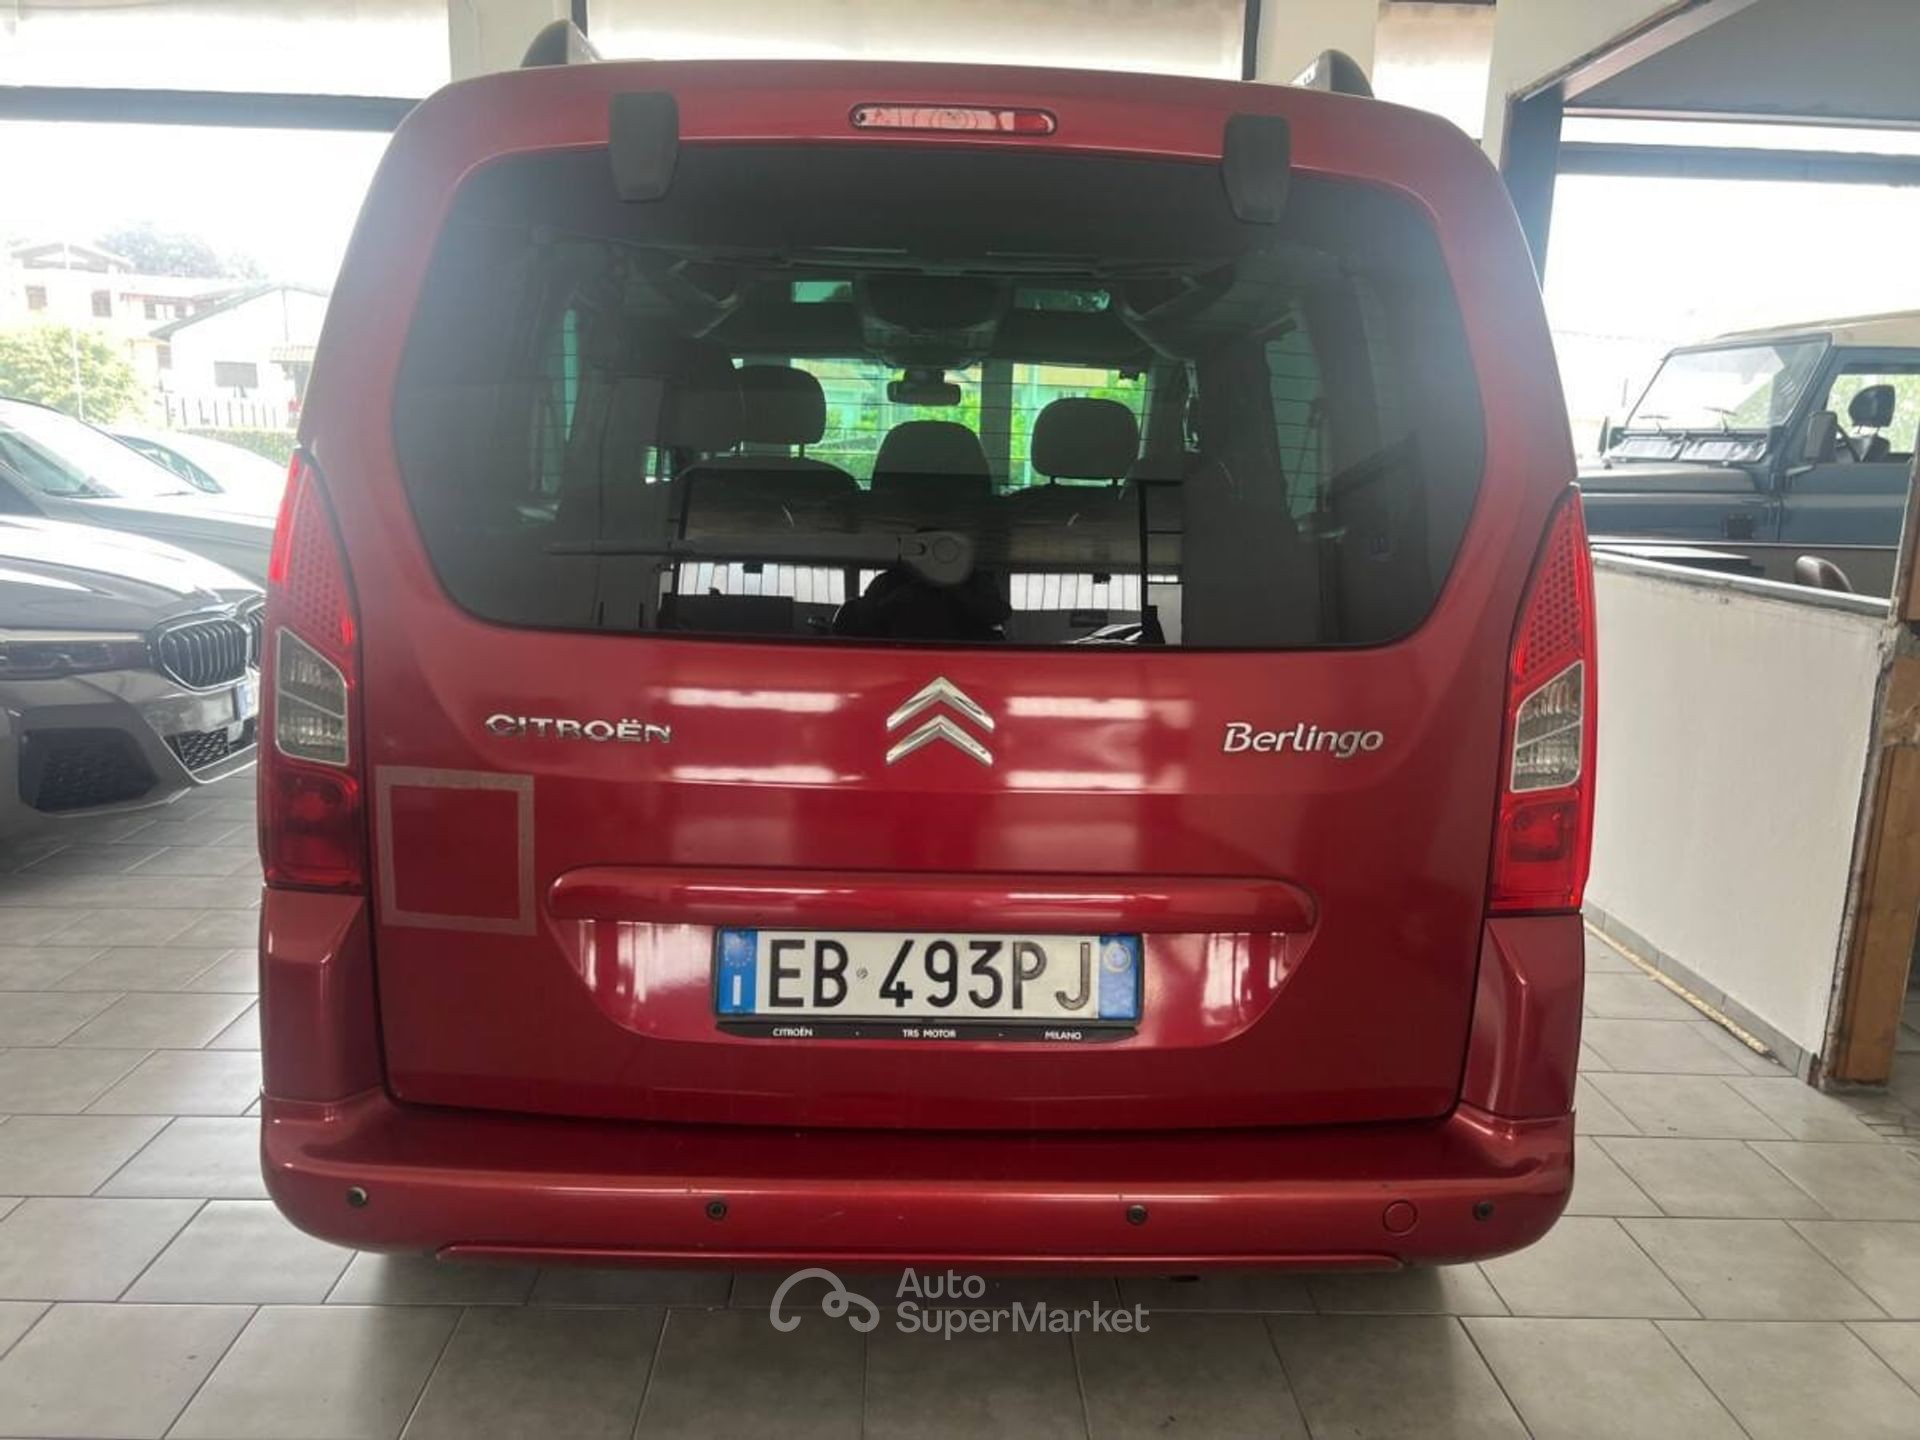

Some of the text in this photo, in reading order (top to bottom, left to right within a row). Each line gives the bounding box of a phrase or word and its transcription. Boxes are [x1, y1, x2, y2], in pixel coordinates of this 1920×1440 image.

[485, 714, 672, 744] CITROËN
[1223, 722, 1385, 759] Berlingo
[769, 939, 1091, 1010] EB 493PJ
[923, 1028, 957, 1039] MOTOR
[1044, 1030, 1082, 1041] MILANO
